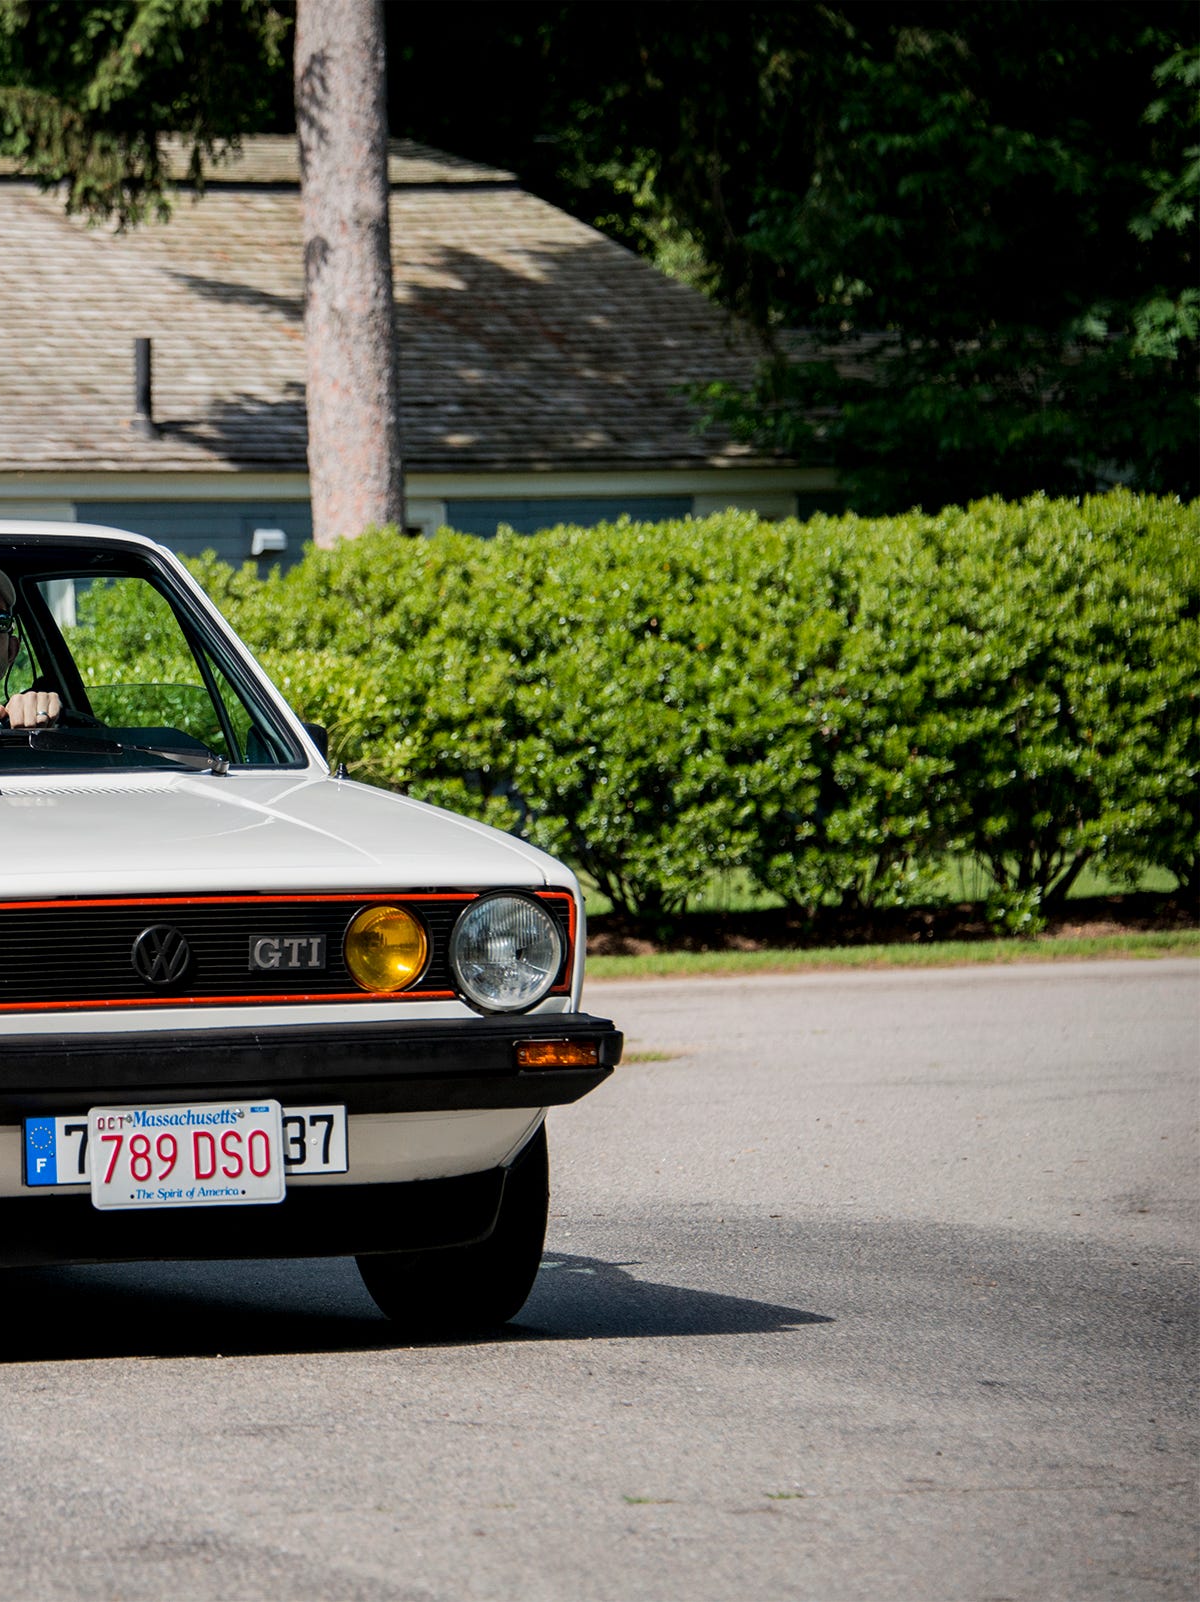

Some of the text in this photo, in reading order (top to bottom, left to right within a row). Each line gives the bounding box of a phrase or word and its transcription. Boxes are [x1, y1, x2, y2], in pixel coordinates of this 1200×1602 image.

[131, 924, 190, 984] VW
[254, 938, 321, 969] GTI
[97, 1116, 125, 1130] OCT
[132, 1109, 237, 1128] Massachusetts
[64, 1114, 334, 1174] 7 37
[100, 1129, 271, 1184] 789 DSO
[37, 1158, 47, 1173] F
[136, 1186, 239, 1201] The Spirit of America
